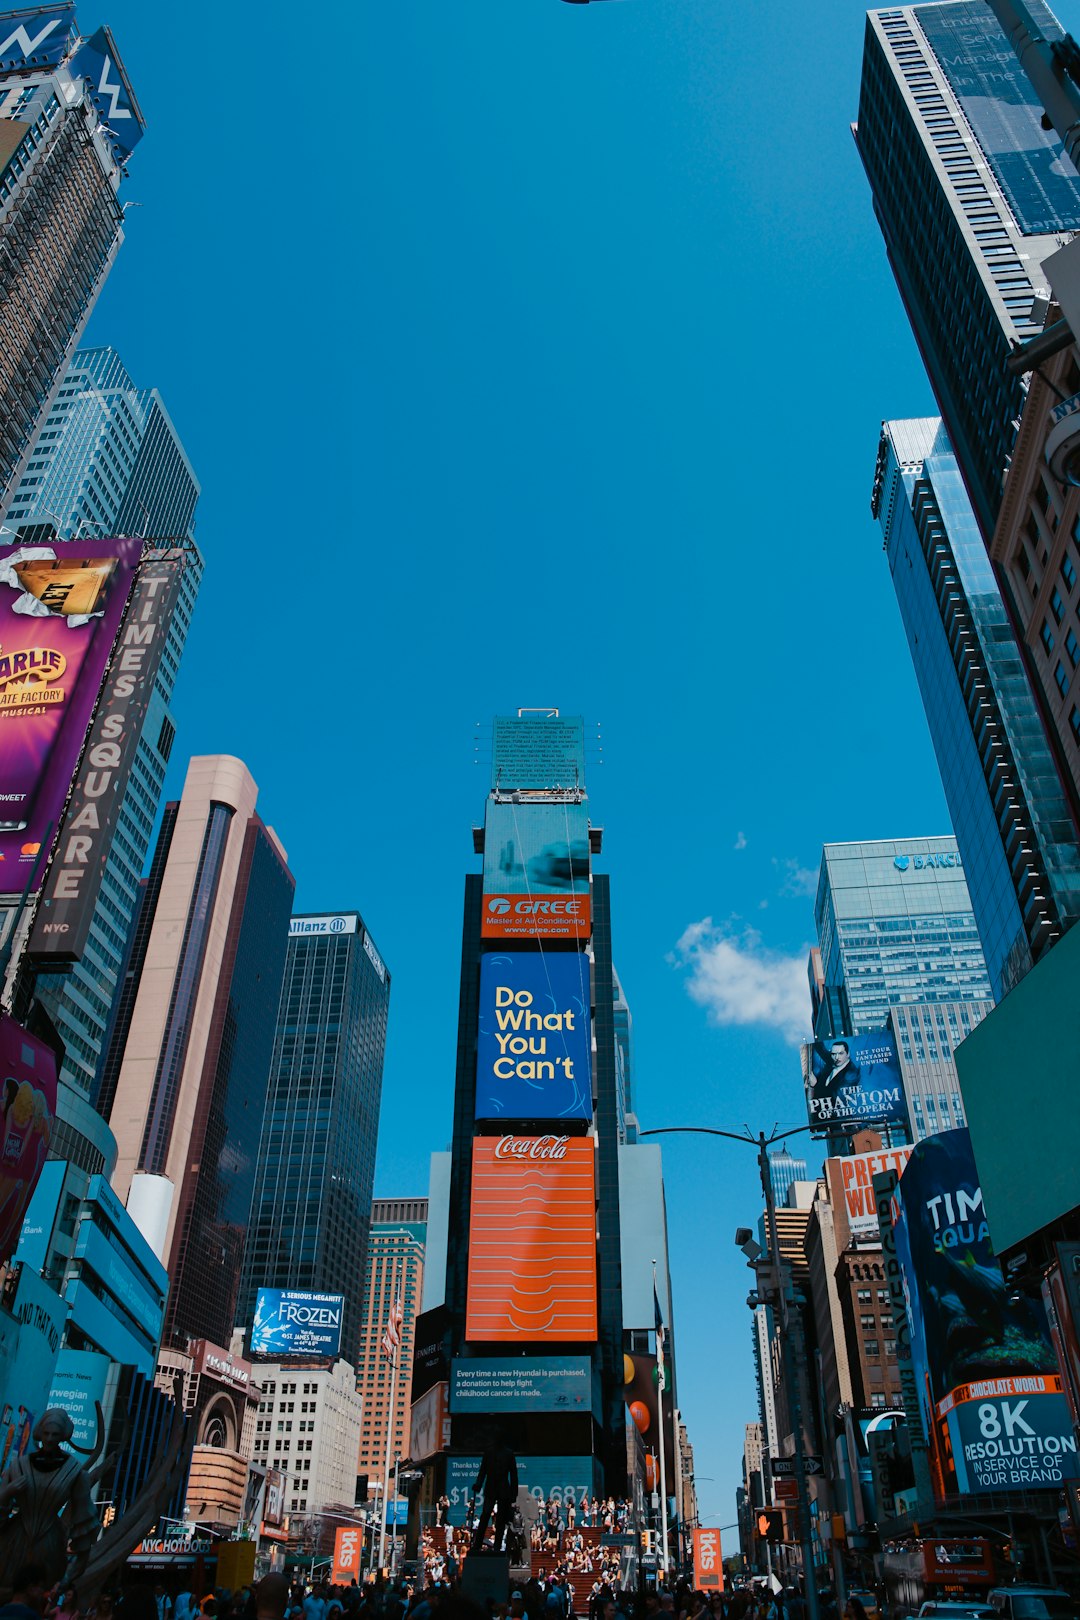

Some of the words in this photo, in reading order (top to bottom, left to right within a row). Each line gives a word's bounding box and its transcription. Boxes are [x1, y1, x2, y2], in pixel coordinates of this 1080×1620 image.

[113, 577, 168, 699] TIMES
[21, 690, 62, 703] FACTORY
[2, 706, 47, 718] MUSICAL
[52, 714, 126, 899] SQUARE
[514, 900, 582, 914] GREE
[42, 923, 70, 934] NYC
[486, 917, 513, 925] Master
[514, 917, 523, 925] of
[524, 917, 535, 925] Air
[537, 917, 586, 926] Conditioning
[495, 986, 534, 1007] Do
[495, 1008, 575, 1031] What
[494, 1032, 546, 1055] You
[871, 1046, 891, 1054] YOUR
[855, 1051, 893, 1062] FANTASIES
[860, 1057, 889, 1066] UNWIND
[493, 1056, 574, 1079] Can't
[840, 1084, 864, 1095] THE
[809, 1087, 901, 1114] PHANTOM
[818, 1108, 834, 1120] OF
[834, 1106, 857, 1118] THE
[857, 1102, 894, 1115] OPERA
[494, 1134, 571, 1160] Coca-Cola
[287, 1292, 312, 1300] SERIOUS
[278, 1302, 340, 1326] FROZEN
[18, 1303, 34, 1325] AND
[34, 1305, 51, 1336] THAT
[47, 1323, 59, 1354] KID
[75, 1373, 92, 1381] News
[456, 1370, 476, 1378] Every
[476, 1369, 492, 1377] time
[512, 1369, 541, 1378] Hyundai
[542, 1369, 548, 1377] is
[548, 1368, 587, 1378] purchased,
[455, 1389, 490, 1397] childhood
[500, 1379, 516, 1388] help
[516, 1379, 533, 1388] fight
[969, 1378, 1014, 1398] CHOCOLATE
[1013, 1377, 1046, 1393] WORLD
[900, 1369, 926, 1452] EXPERIENCE
[977, 1399, 1037, 1439] 8K
[964, 1435, 1078, 1461] RESOLUTION
[451, 1461, 473, 1469] Thanks
[473, 1461, 480, 1469] to
[973, 1461, 983, 1474] IN
[984, 1455, 1040, 1472] SERVICE
[1042, 1454, 1063, 1468] OF
[976, 1471, 1008, 1487] YOUR
[1010, 1468, 1063, 1484] BRAND
[141, 1538, 162, 1553] NYC
[340, 1530, 358, 1568] tkts
[700, 1531, 717, 1570] tkts
